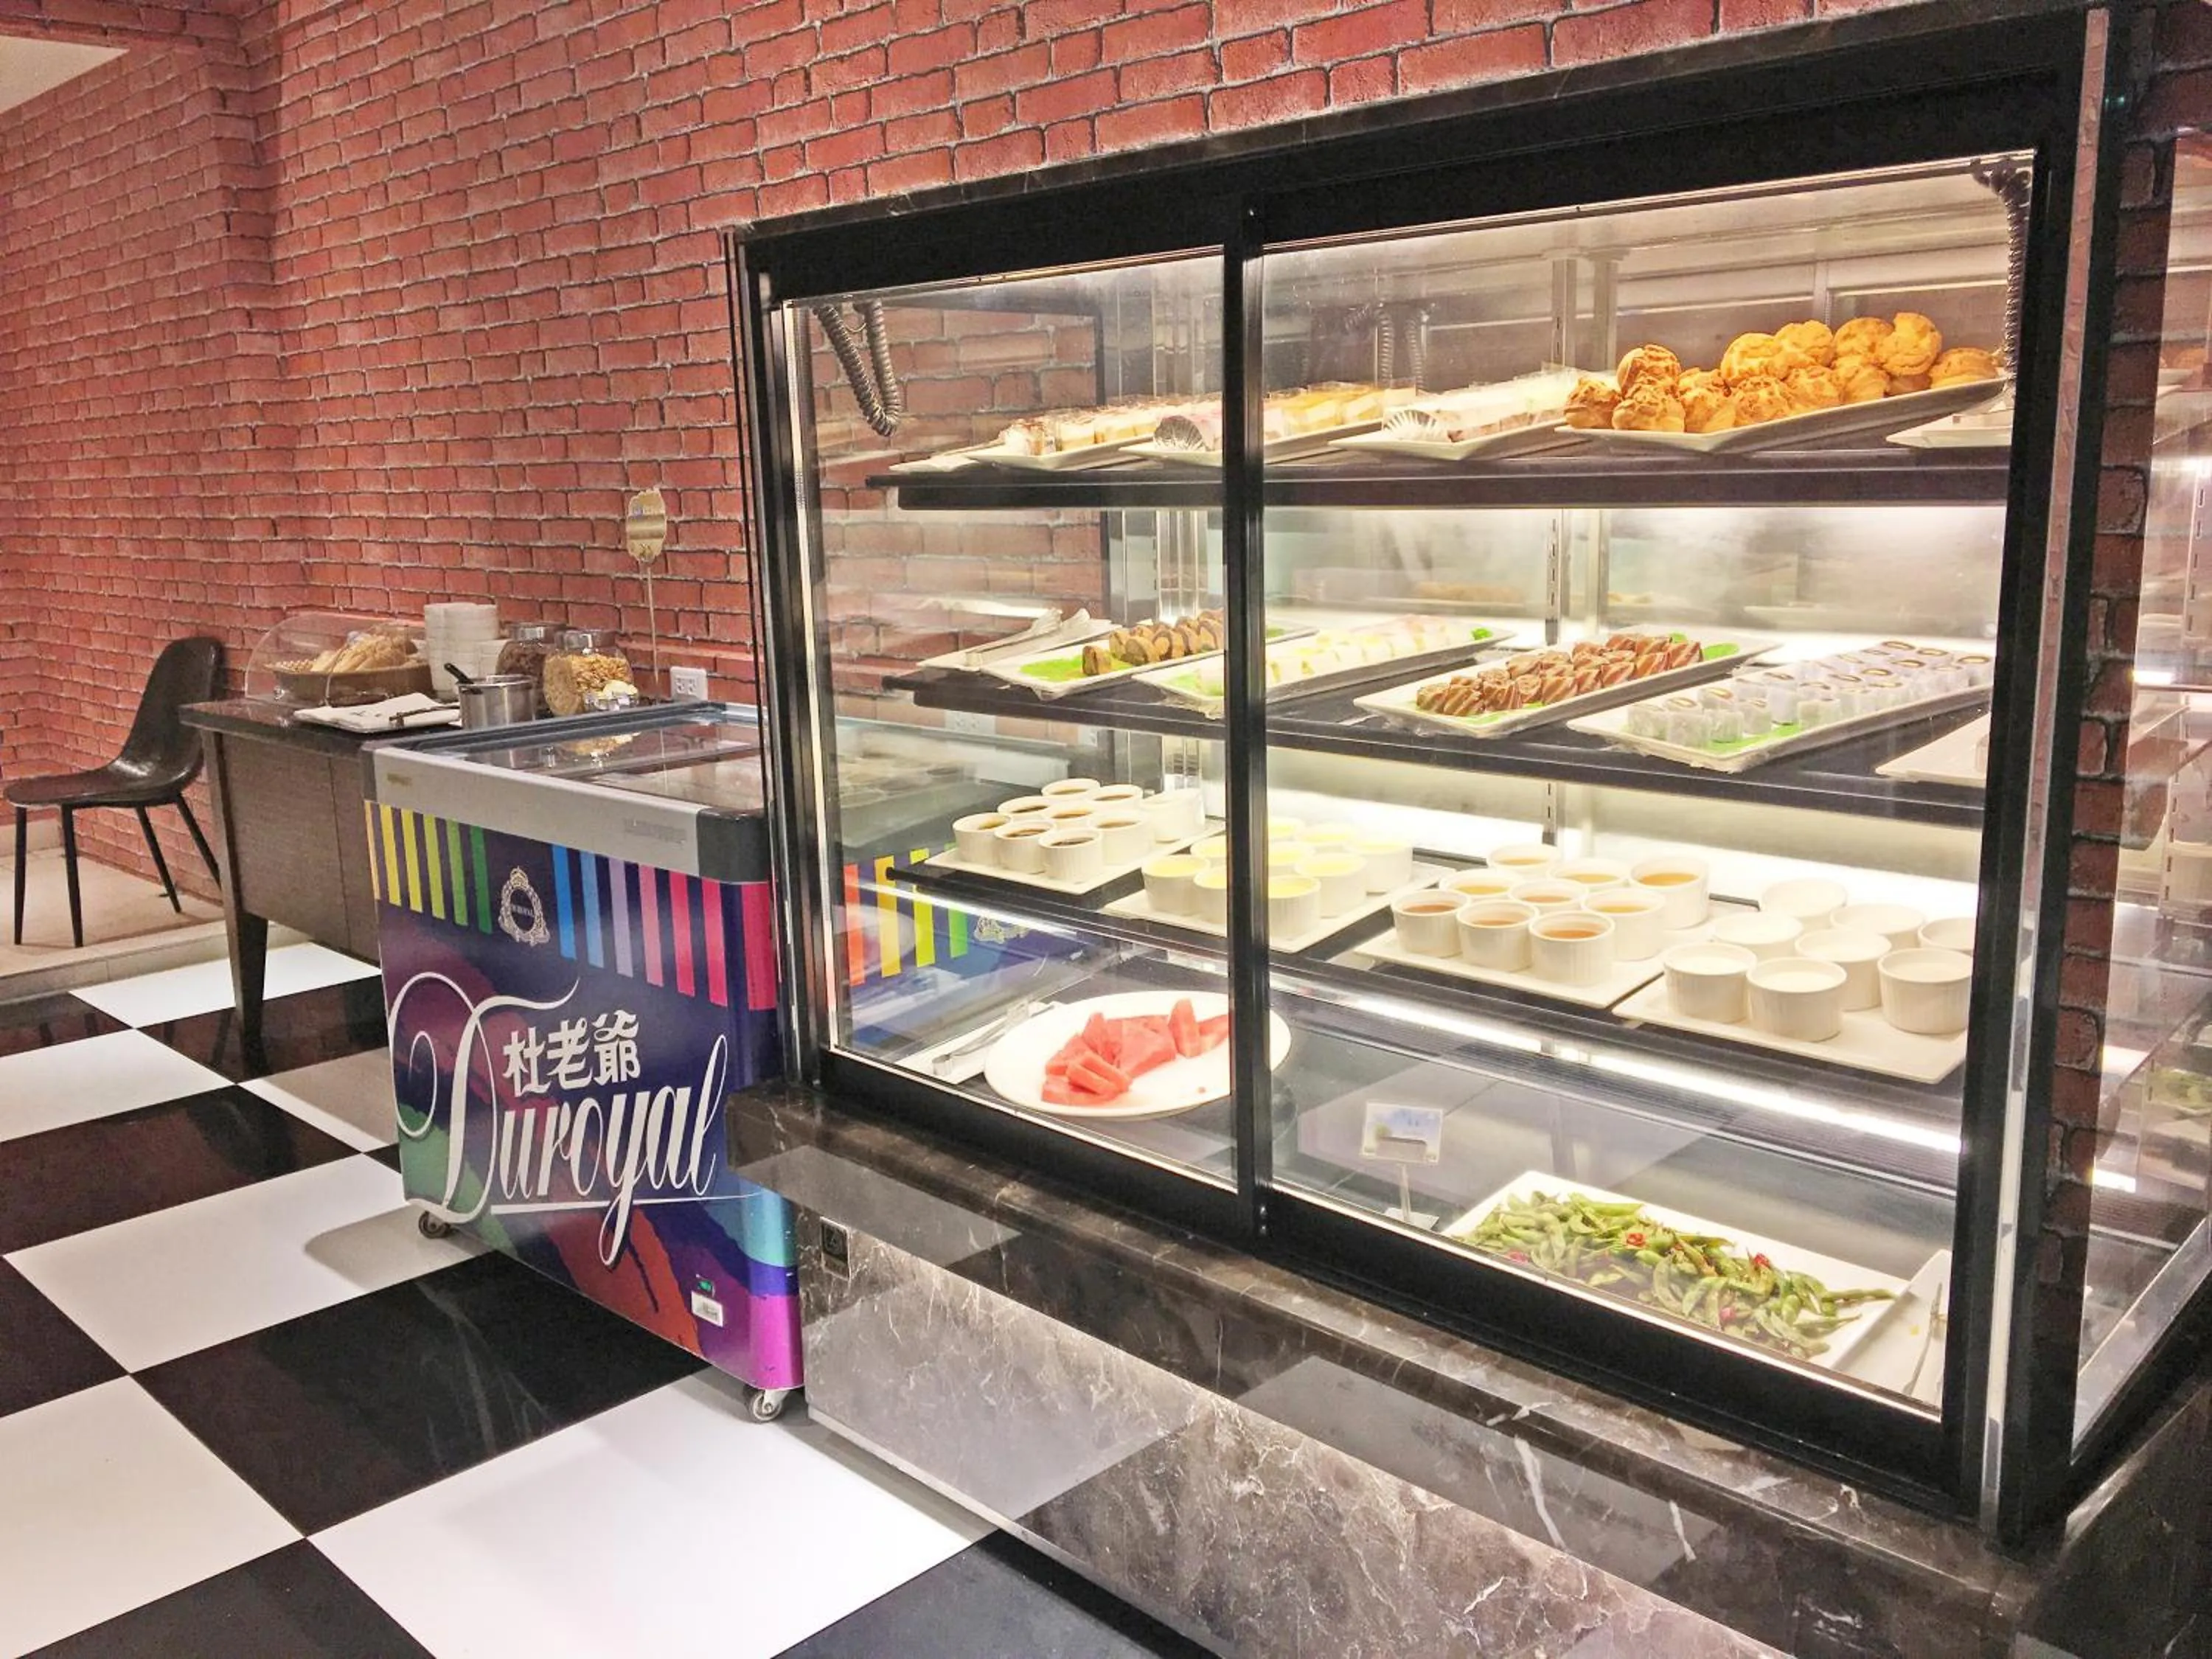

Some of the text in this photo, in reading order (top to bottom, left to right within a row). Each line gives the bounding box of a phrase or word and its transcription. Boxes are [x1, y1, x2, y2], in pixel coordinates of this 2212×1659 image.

[388, 971, 728, 1266] Duroyal
[502, 1009, 641, 1098] 杜老爺
